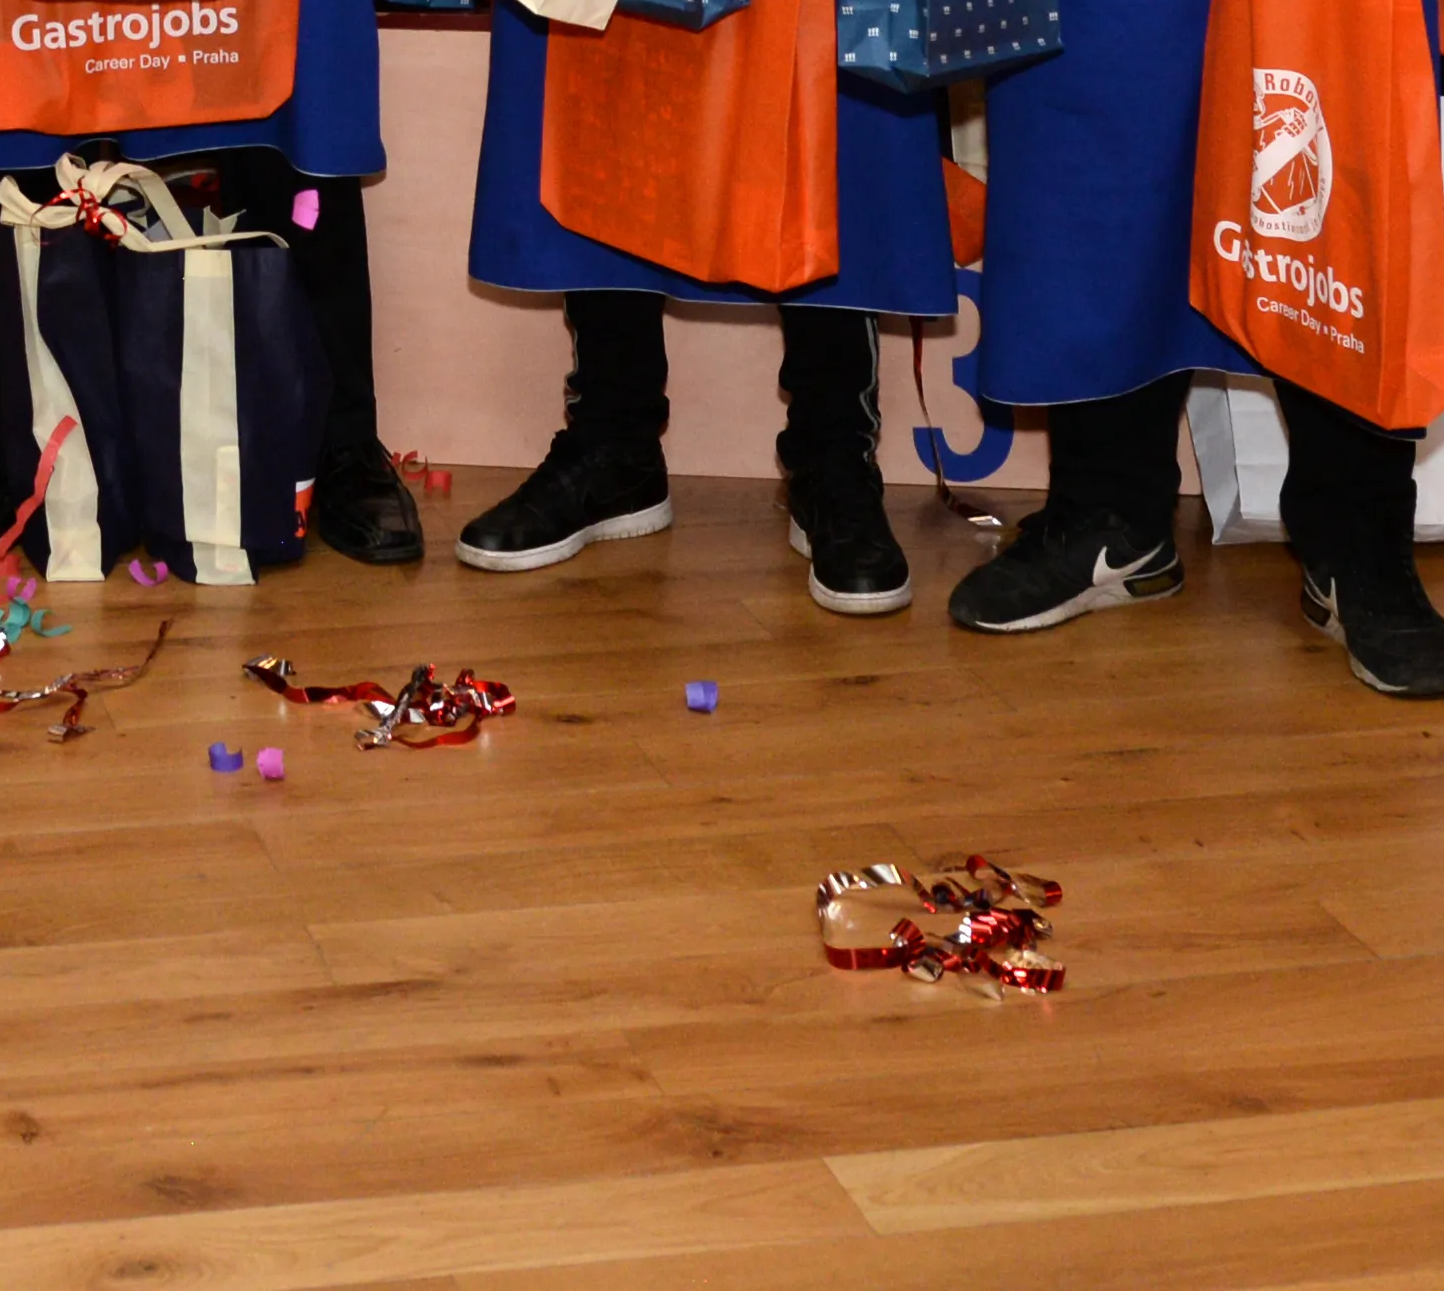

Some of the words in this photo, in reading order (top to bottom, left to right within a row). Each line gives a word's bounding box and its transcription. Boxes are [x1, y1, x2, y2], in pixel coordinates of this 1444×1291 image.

[11, 1, 239, 52] Gastrojobs
[84, 56, 135, 74] Career
[140, 53, 171, 71] Day
[193, 49, 239, 65] Praha
[1256, 296, 1299, 321] Career
[1301, 309, 1322, 335] Day
[1330, 327, 1365, 355] Praha
